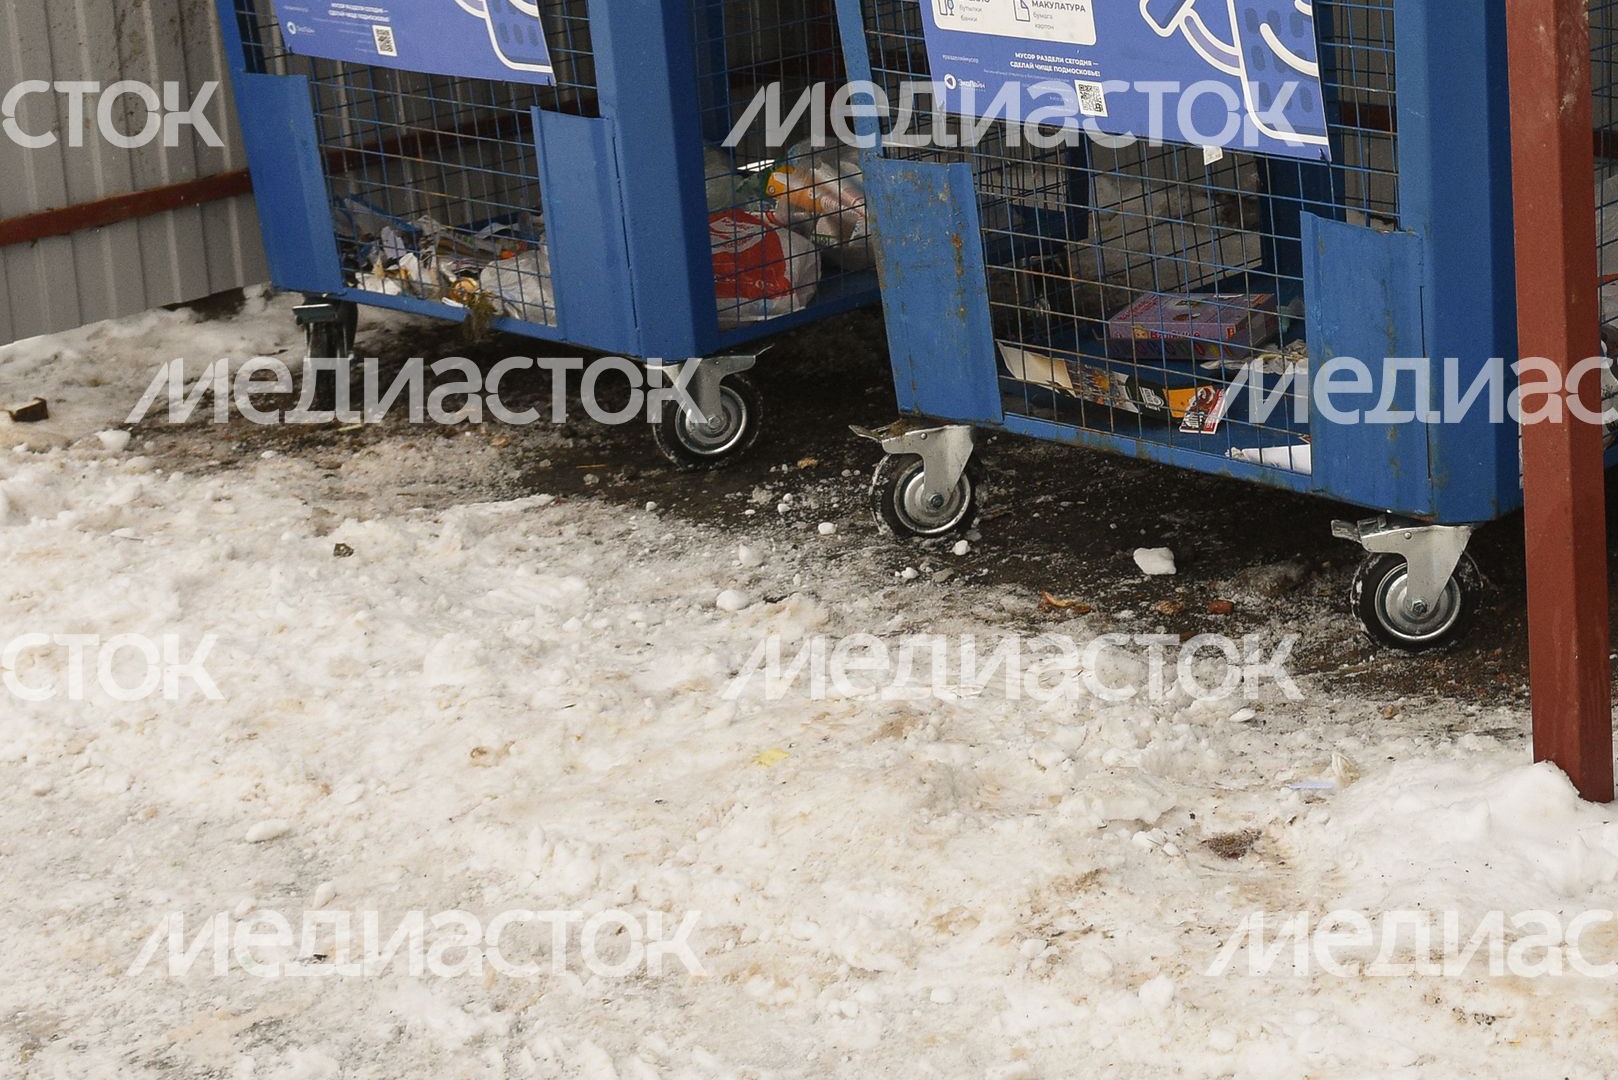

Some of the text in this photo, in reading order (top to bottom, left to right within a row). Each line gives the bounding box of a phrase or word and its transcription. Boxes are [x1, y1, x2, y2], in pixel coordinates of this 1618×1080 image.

[1031, 0, 1086, 12] МАКУЛАТУРА
[1015, 52, 1035, 60] МУСОР
[1036, 54, 1064, 64] РАЗДЕЛИ
[1065, 58, 1092, 67] СЕГОДНЯ
[1010, 61, 1034, 70] СДЕЛАЙ
[1053, 66, 1101, 77] ПОДМОСКОВЬЕ!
